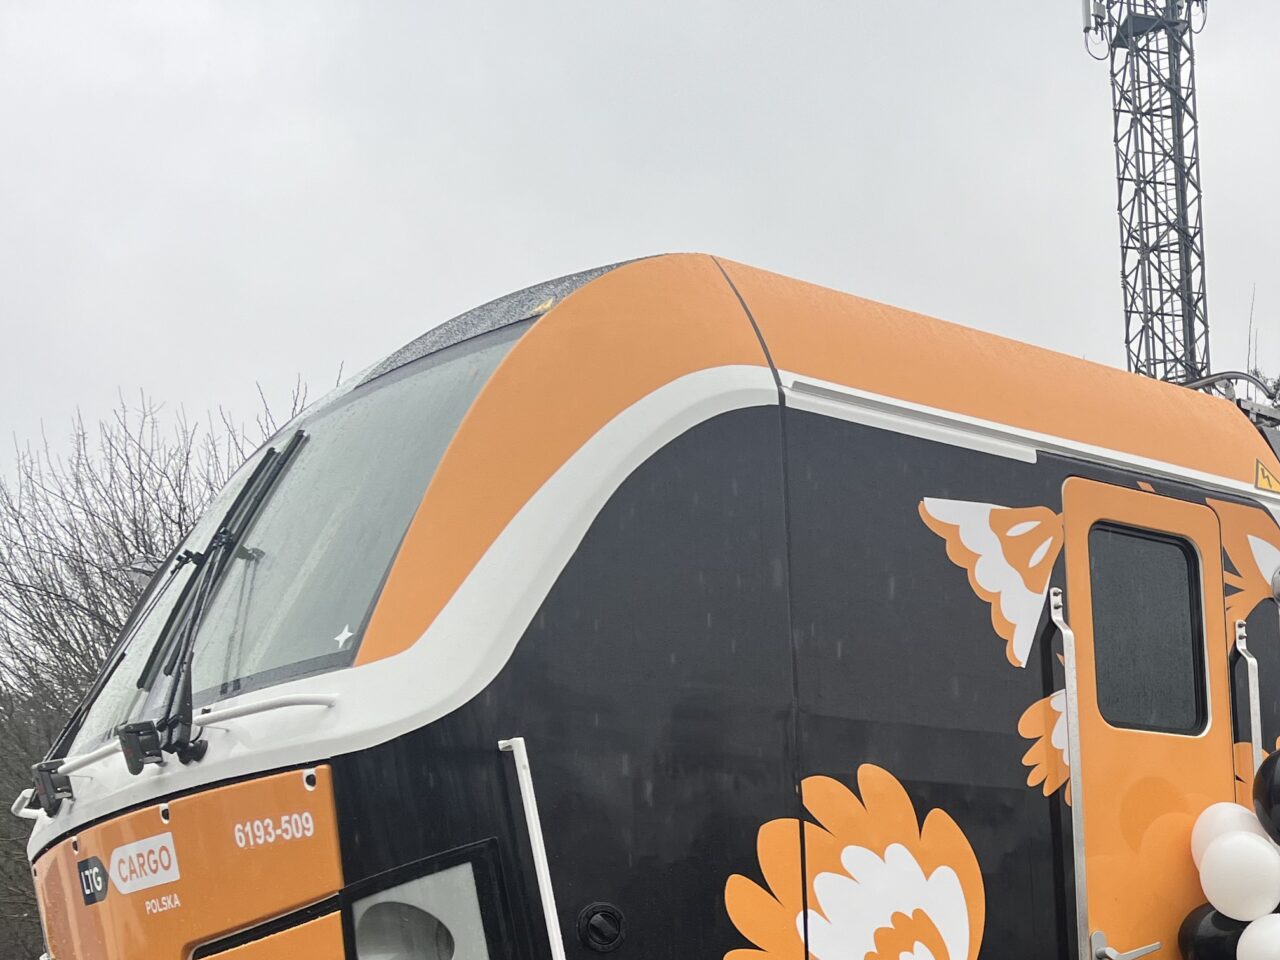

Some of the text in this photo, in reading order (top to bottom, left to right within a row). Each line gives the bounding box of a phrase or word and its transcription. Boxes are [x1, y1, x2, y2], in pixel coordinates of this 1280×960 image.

[234, 811, 314, 848] 6193-509
[80, 845, 172, 895] LTG CARGO
[145, 893, 181, 915] POLSKA
